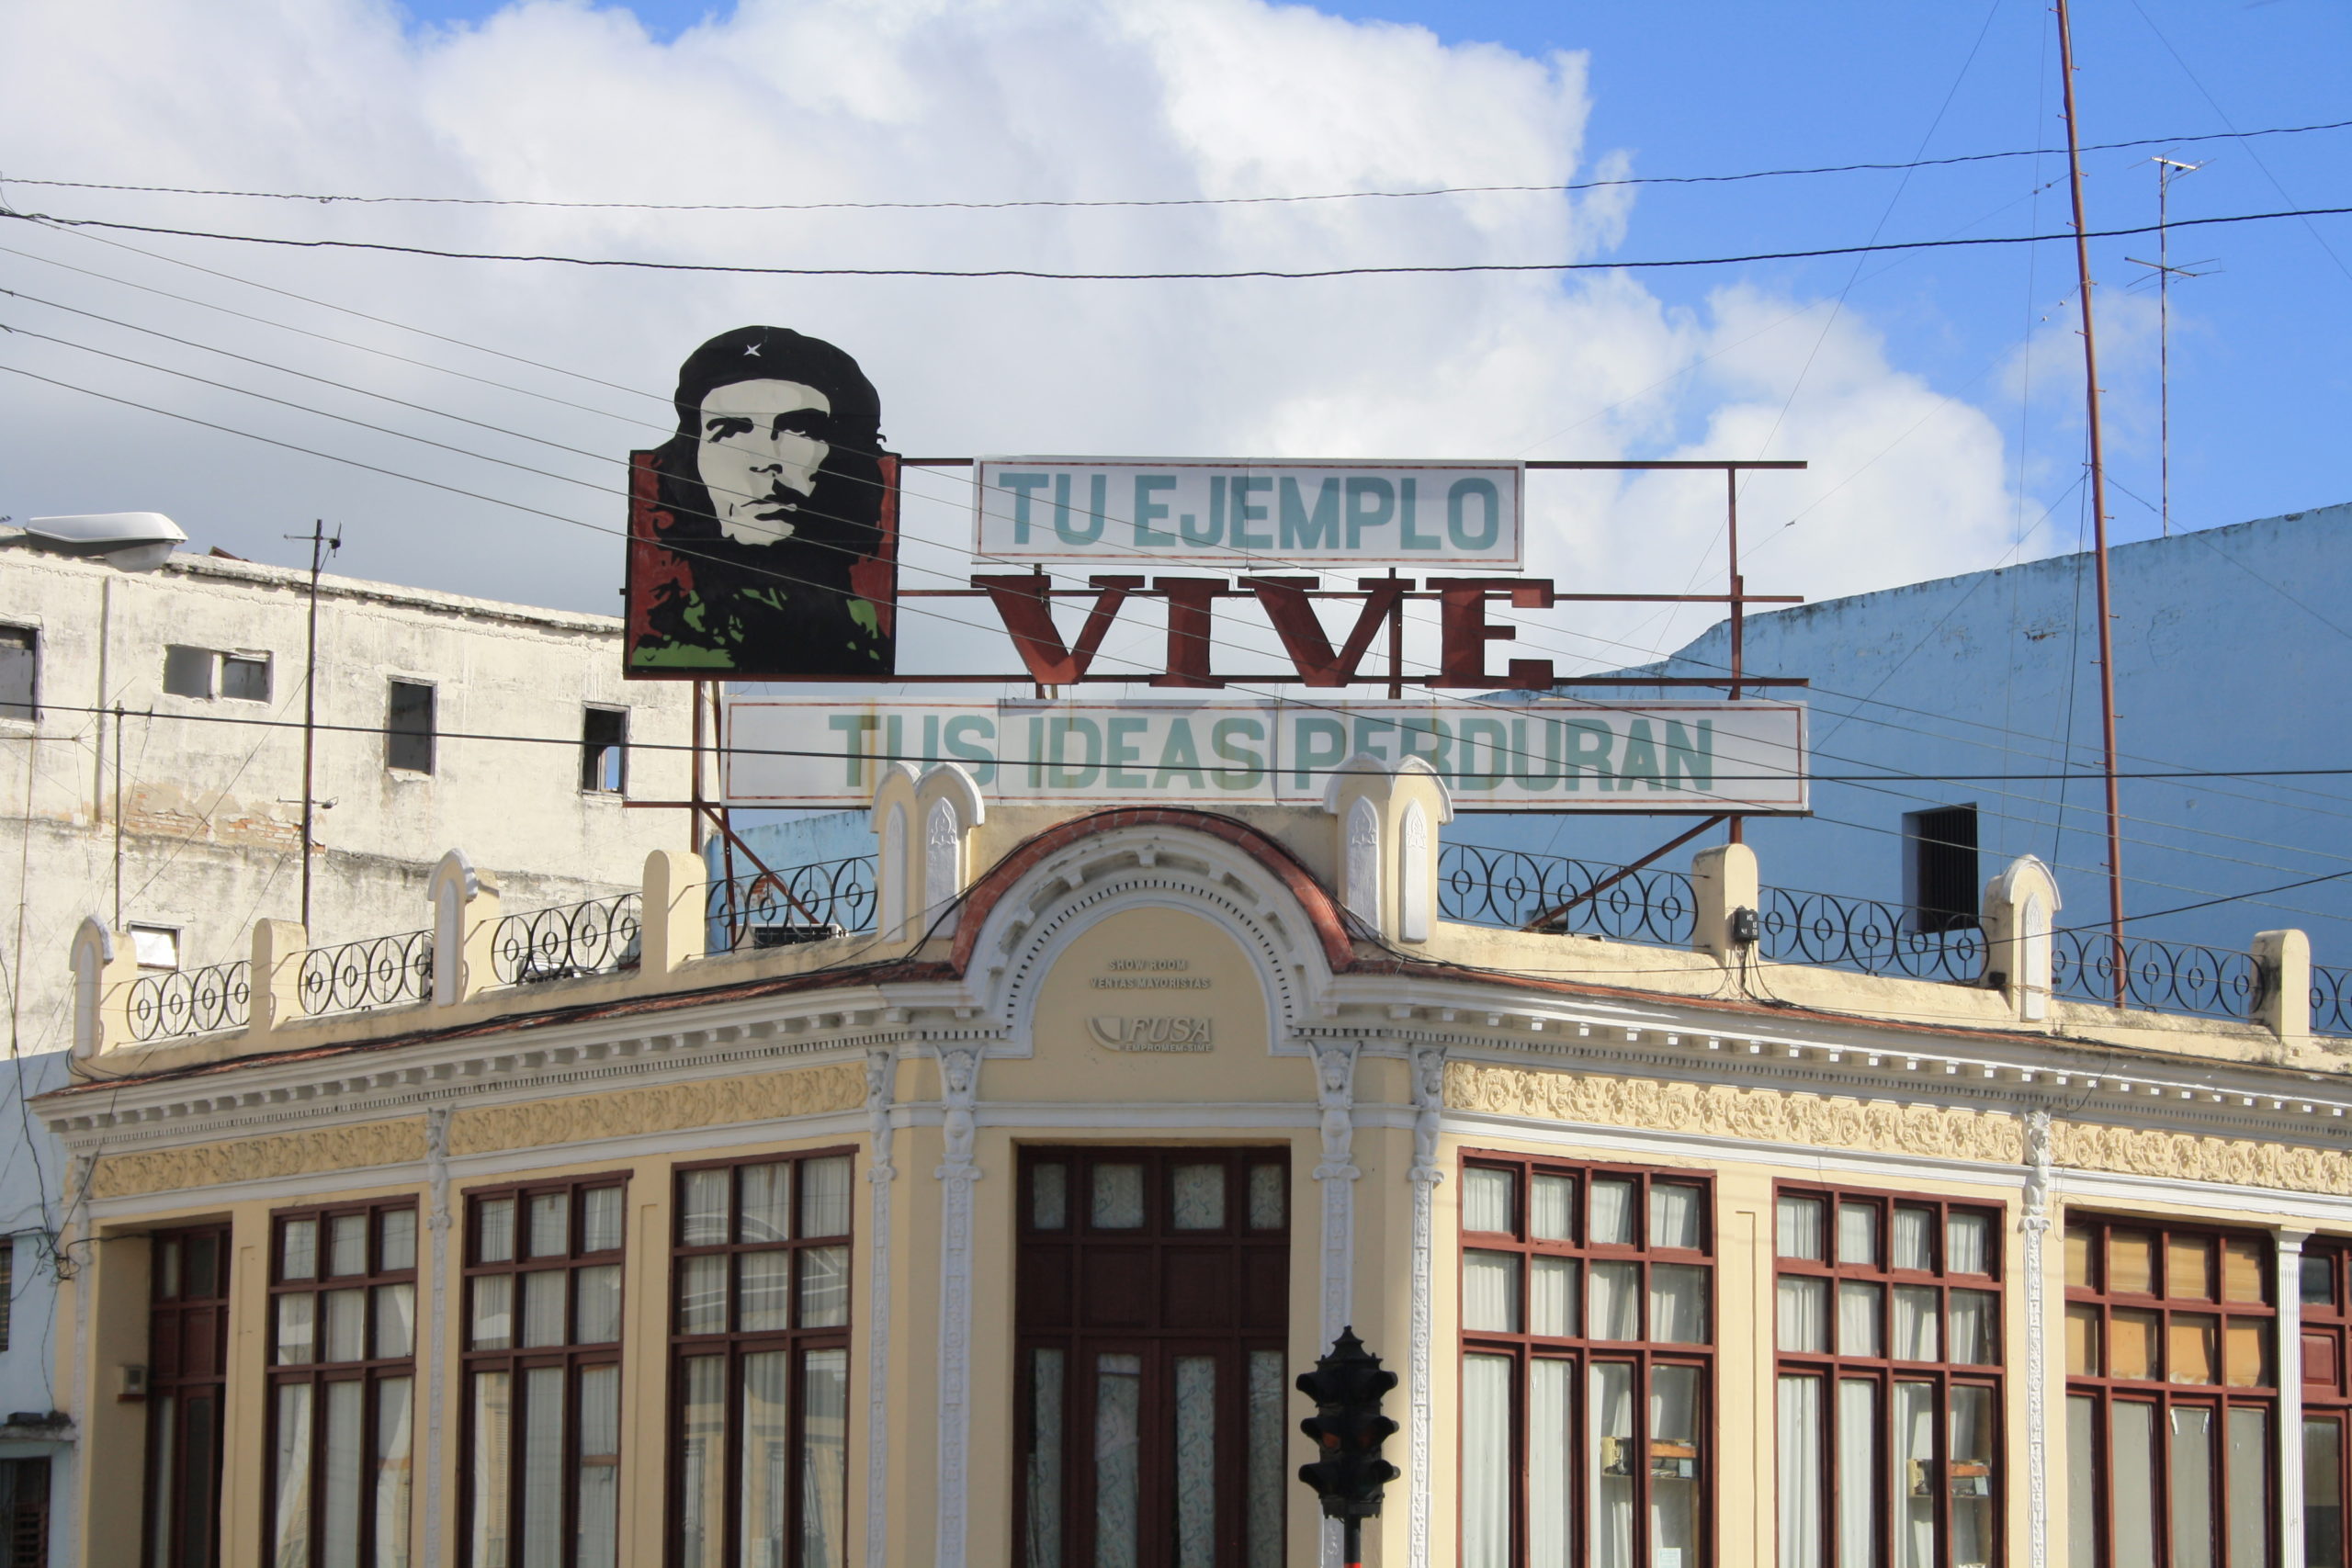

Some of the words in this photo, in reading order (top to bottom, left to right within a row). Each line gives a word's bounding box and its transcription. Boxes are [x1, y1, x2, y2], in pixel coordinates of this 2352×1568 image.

[999, 473, 1106, 546] TU
[1133, 475, 1500, 551] EJEMPLO
[970, 574, 1555, 690] VIVE
[829, 715, 995, 787] TUS
[1027, 716, 1265, 791] IDEAS
[1295, 717, 1713, 793] PERDURAN
[1090, 976, 1135, 988] VENTAS
[1136, 976, 1211, 988] MAYORISTAS
[1108, 959, 1145, 971] SHOW
[1149, 959, 1188, 971] ROOM
[1128, 1016, 1212, 1043] FUSA
